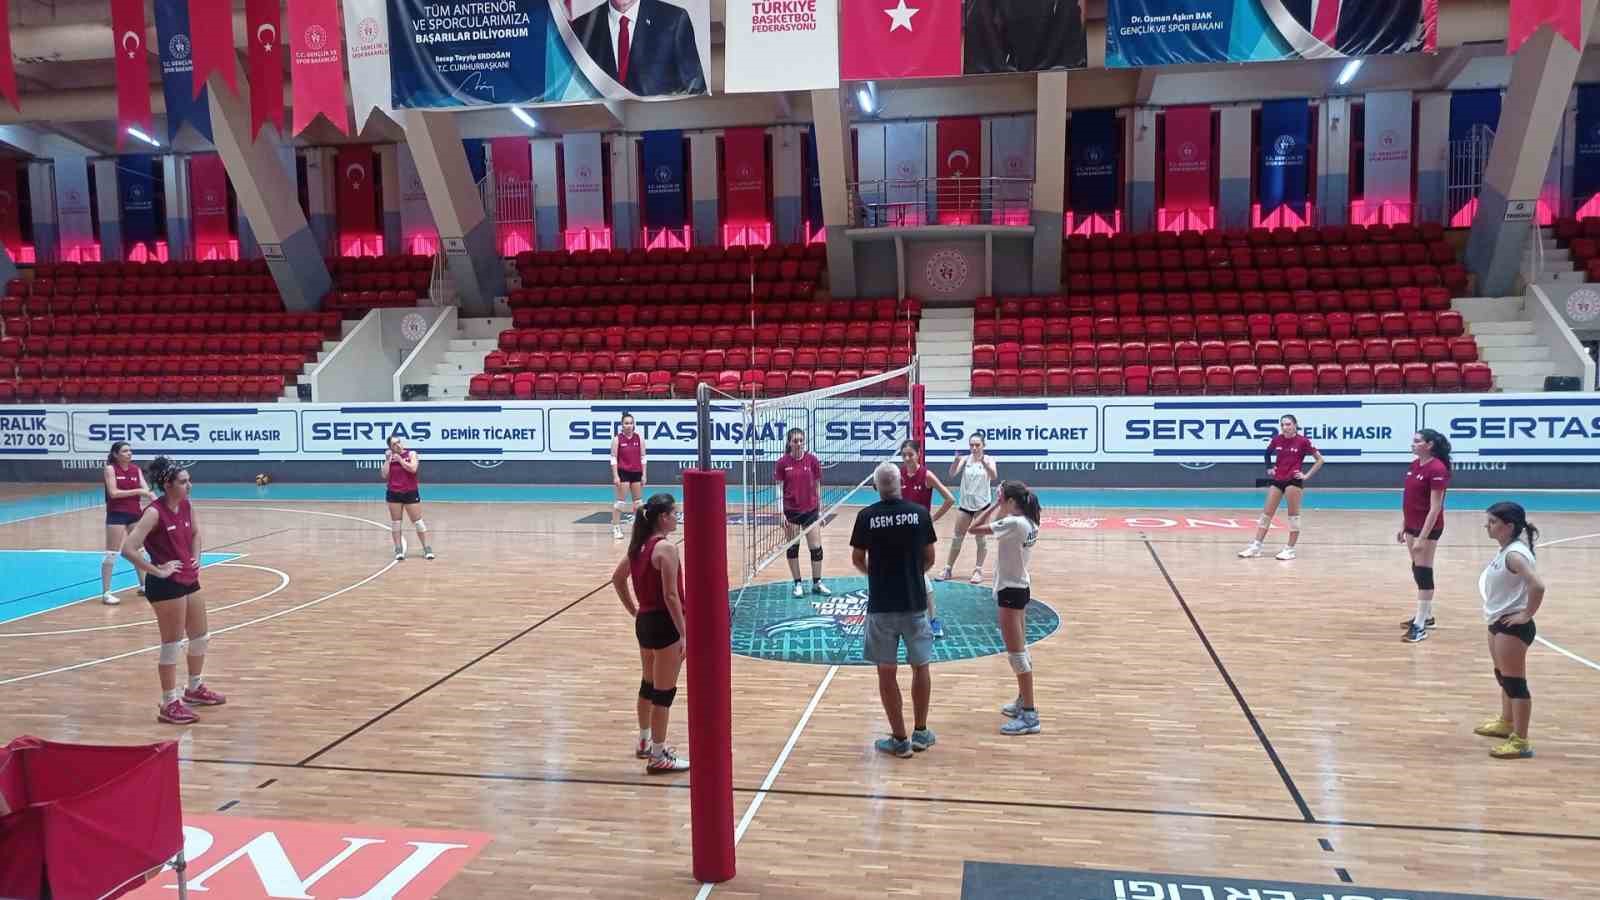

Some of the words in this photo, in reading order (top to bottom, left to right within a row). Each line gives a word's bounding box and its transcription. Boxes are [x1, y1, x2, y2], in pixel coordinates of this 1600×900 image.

[424, 4, 450, 17] TÜM
[453, 0, 516, 16] ANTRENÖR
[752, 0, 816, 14] TÜRKİYE
[413, 20, 426, 31] VE
[429, 13, 530, 30] SPORCULARIMIZA
[752, 13, 816, 24] BASKETBOL
[1195, 12, 1212, 20] BAK
[752, 23, 816, 33] FEDERASYONU
[1120, 26, 1155, 36] GENÇLİK
[1155, 25, 1166, 33] VE
[1168, 23, 1190, 32] SPOR
[1191, 21, 1224, 31] BAKANI
[416, 32, 471, 44] BAŞARILAR
[473, 28, 528, 40] DİLİYORUM
[477, 51, 511, 60] ERDOĞAN
[88, 423, 200, 443] SERTAŞ
[209, 428, 241, 442] ÇELİK
[245, 429, 280, 441] HASIR
[312, 421, 431, 442] SERTAŞ
[441, 425, 480, 440] DEMİR
[483, 425, 536, 440] TİCARET
[1026, 425, 1088, 440] TİCARET
[1342, 426, 1392, 440] HASIR
[4, 433, 24, 446] 217
[27, 433, 45, 446] 00
[48, 433, 66, 446] 20
[870, 515, 894, 528] ASEM
[896, 513, 919, 525] SPOR
